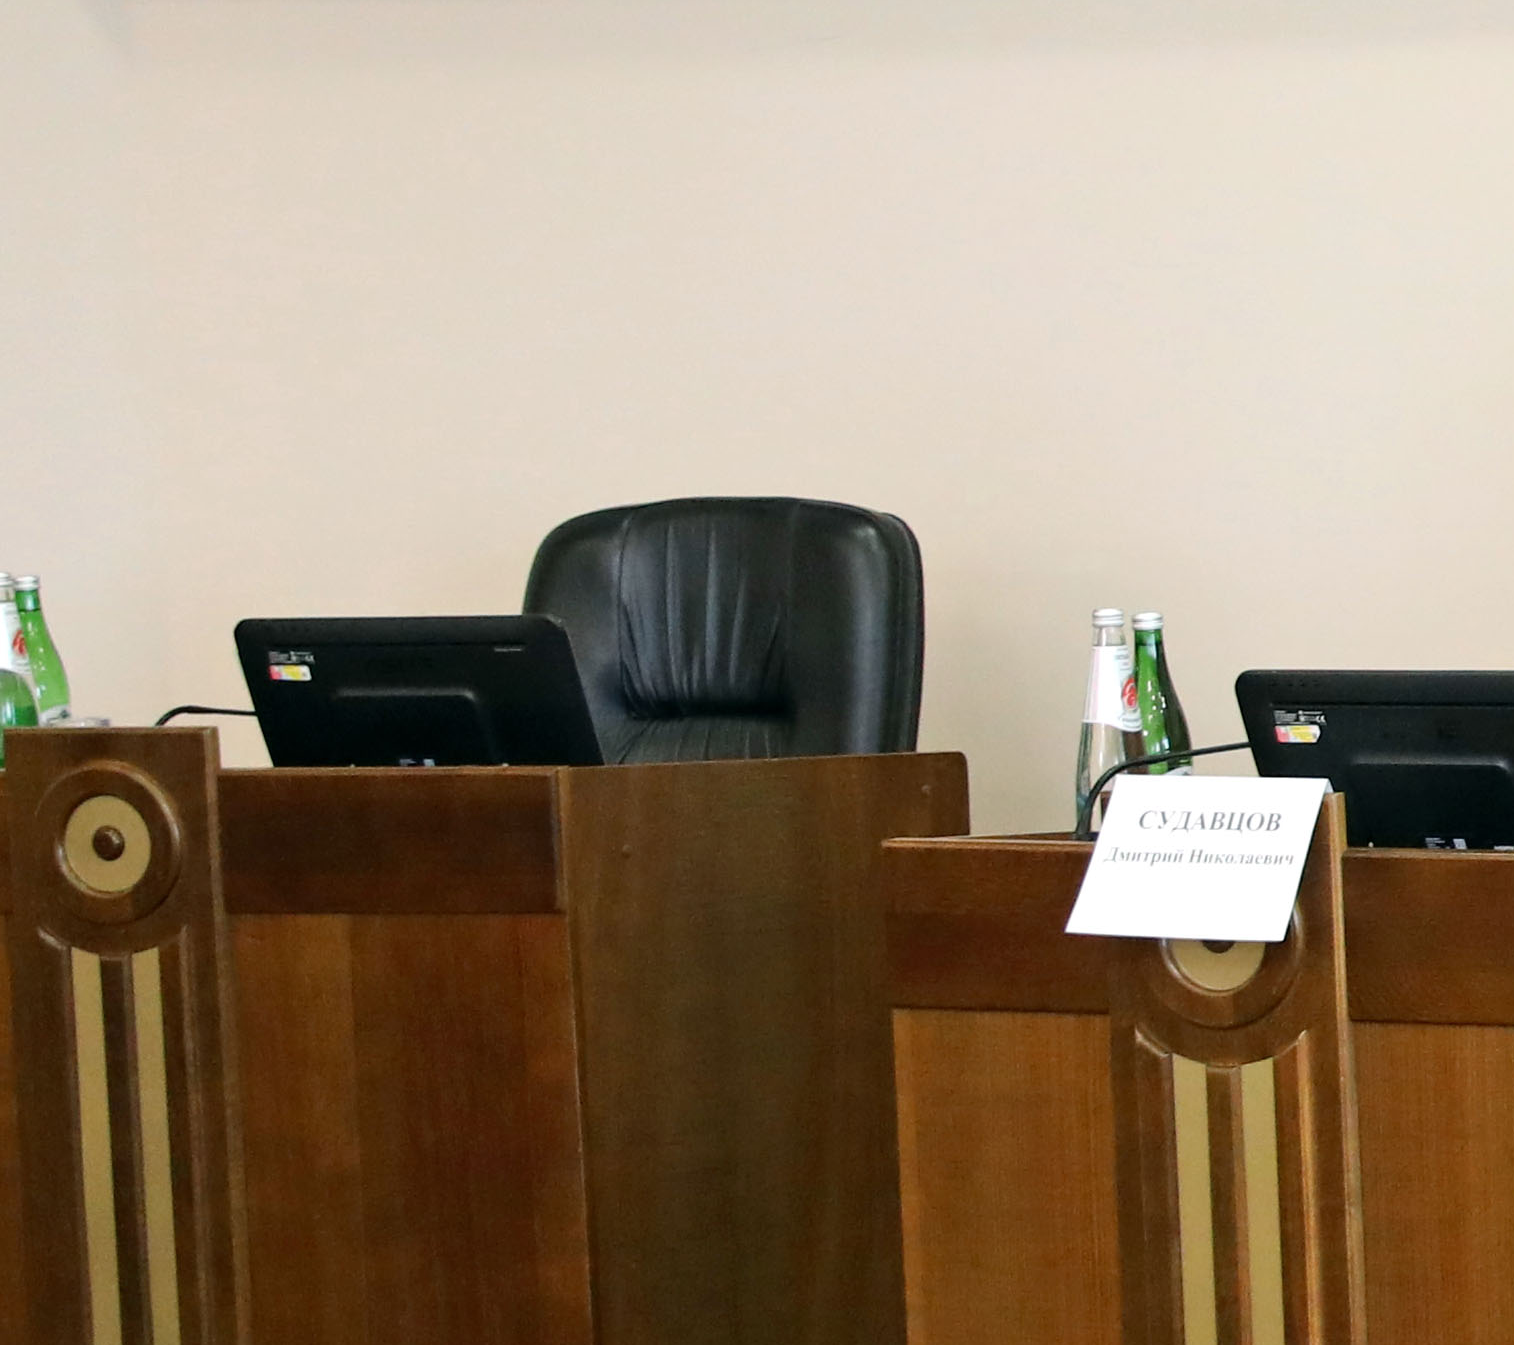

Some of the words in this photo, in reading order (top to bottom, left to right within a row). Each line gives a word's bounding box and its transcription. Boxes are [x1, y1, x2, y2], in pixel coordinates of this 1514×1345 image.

[1138, 810, 1283, 833] СУДАВЦОВ
[1102, 846, 1184, 867] Дмитрий
[1188, 849, 1295, 866] Николаевич
